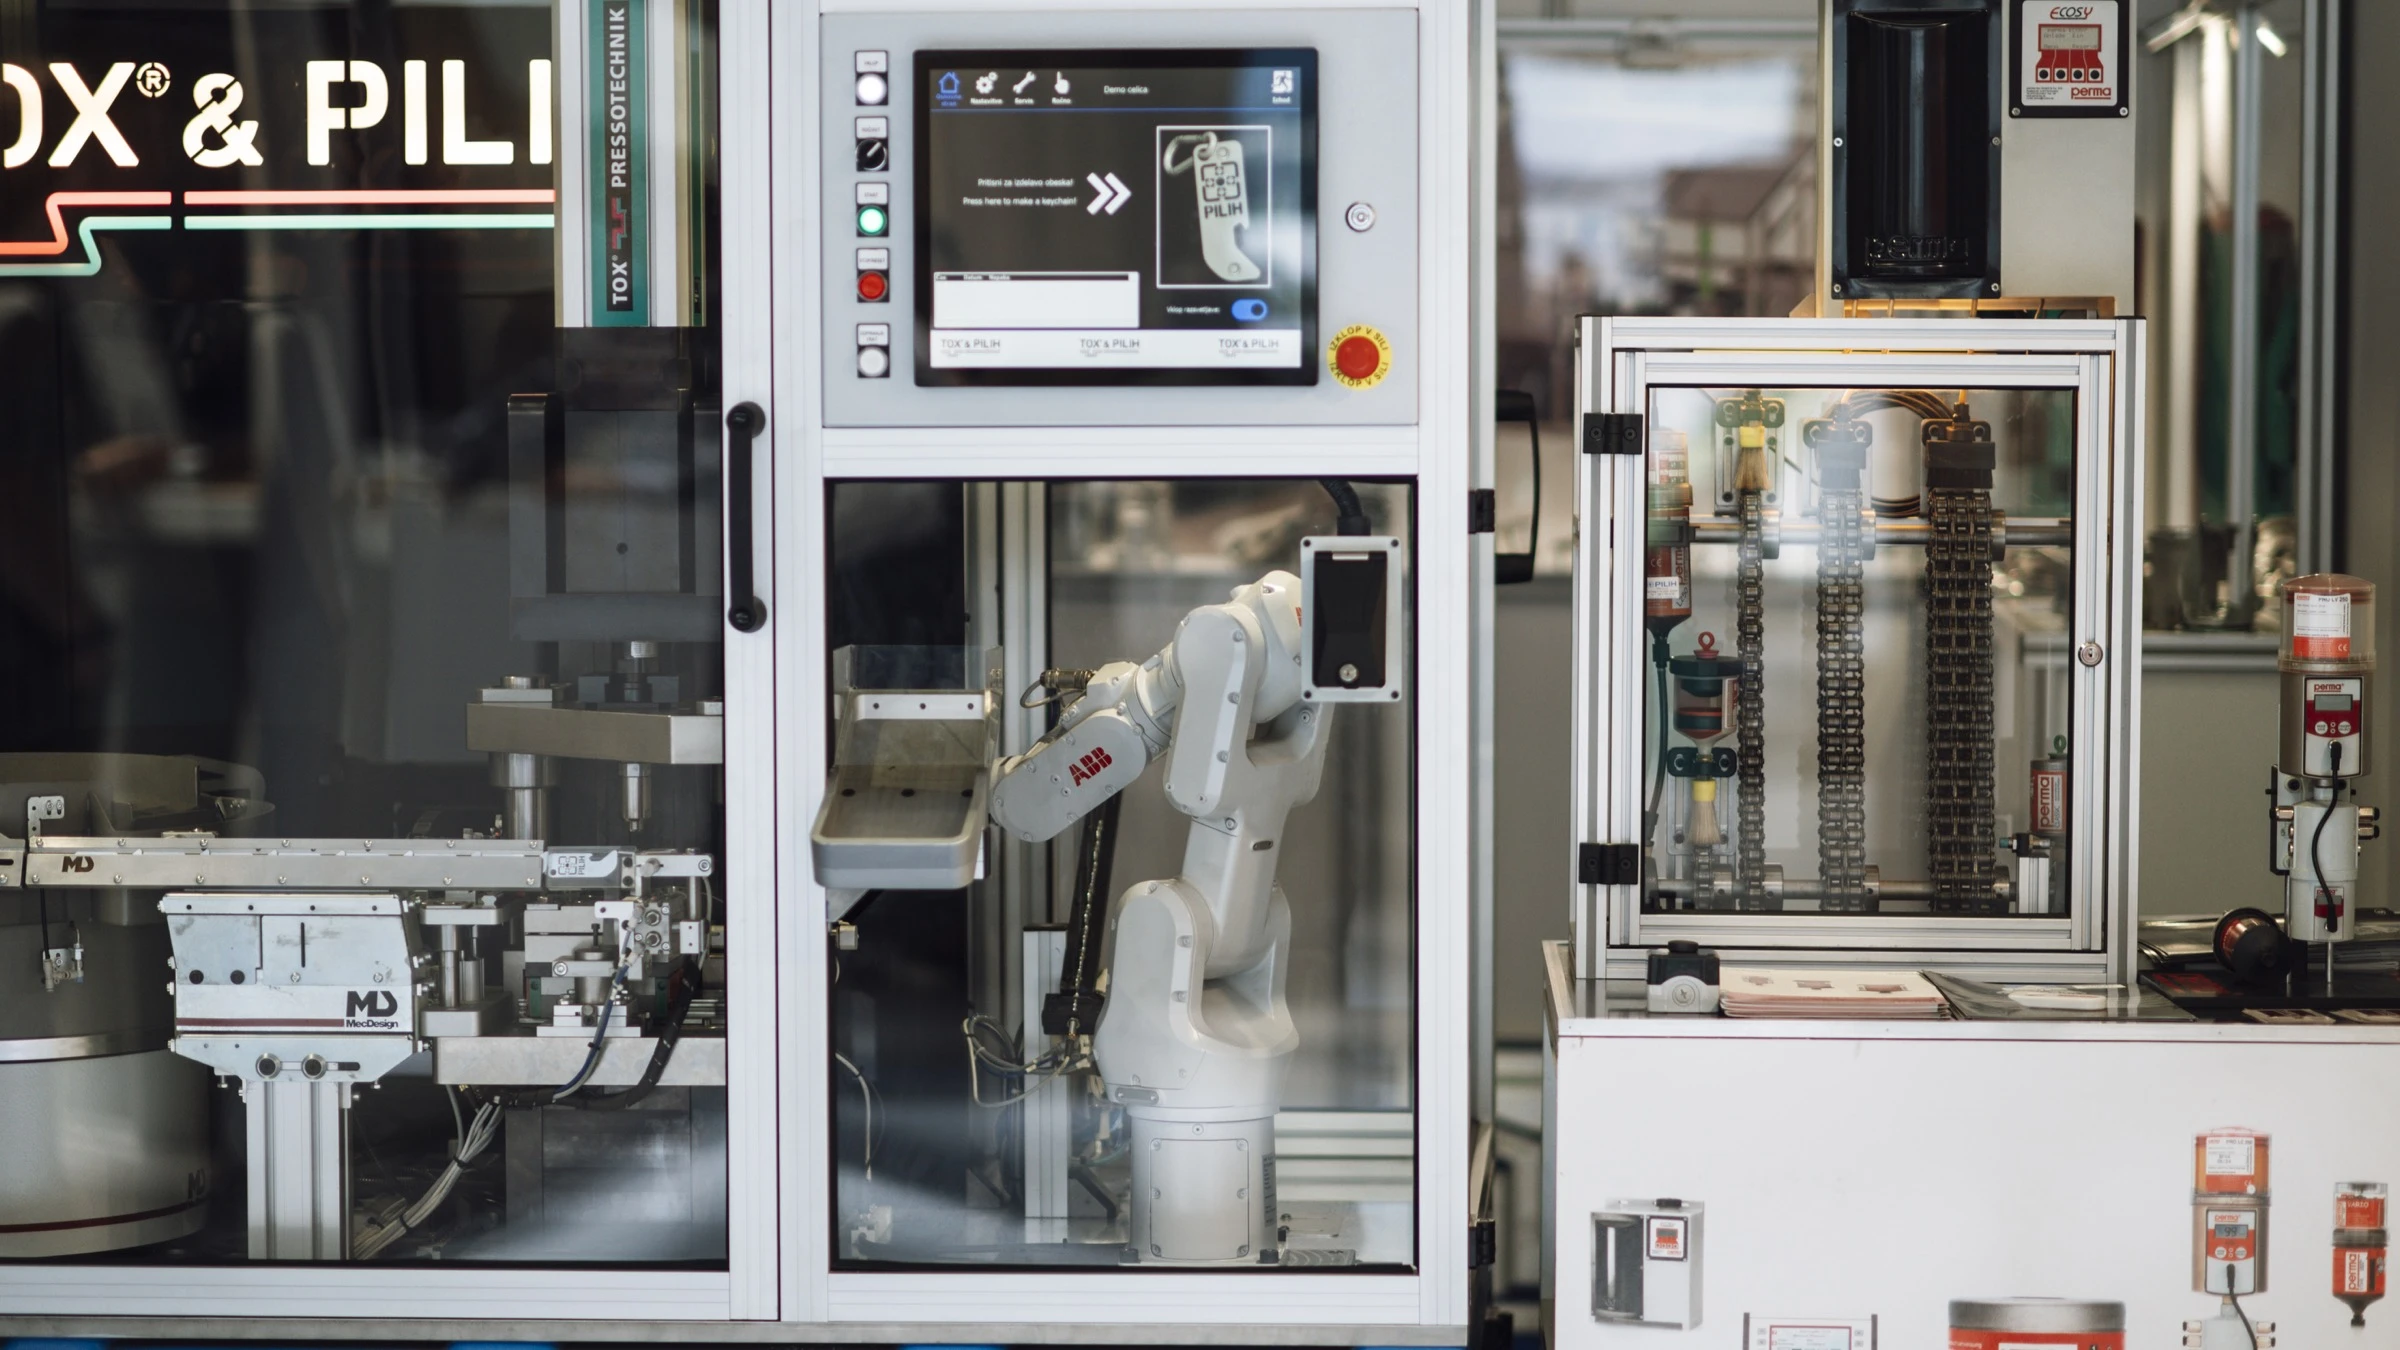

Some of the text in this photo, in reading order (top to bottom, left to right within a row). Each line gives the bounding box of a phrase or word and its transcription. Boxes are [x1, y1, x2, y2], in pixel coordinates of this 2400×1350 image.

[1103, 85, 1149, 94] Demo celica
[2071, 87, 2111, 99] perma
[609, 8, 627, 188] PRESSOTECHNIK
[182, 72, 264, 168] &
[978, 178, 1073, 187] Pritisni za izdelavo obeska!
[963, 197, 982, 205] Press
[984, 197, 1001, 205] here
[1003, 197, 1010, 205] to
[1012, 197, 1033, 205] make
[1042, 197, 1078, 206] keychain!
[1204, 202, 1243, 219] PILIH
[1166, 306, 1183, 315] Vklop
[973, 339, 1001, 348] PILIH
[1112, 339, 1140, 348] PILIH
[1251, 339, 1279, 348] PILIH
[1329, 325, 1362, 351] IZKLOP
[1373, 332, 1389, 351] SILI
[1329, 362, 1362, 388] IZKLOP
[1366, 377, 1372, 386] V
[1068, 746, 1113, 787] ABB
[2040, 776, 2054, 828] perma
[345, 1019, 399, 1030] MecDesign
[2348, 1253, 2357, 1290] perma
